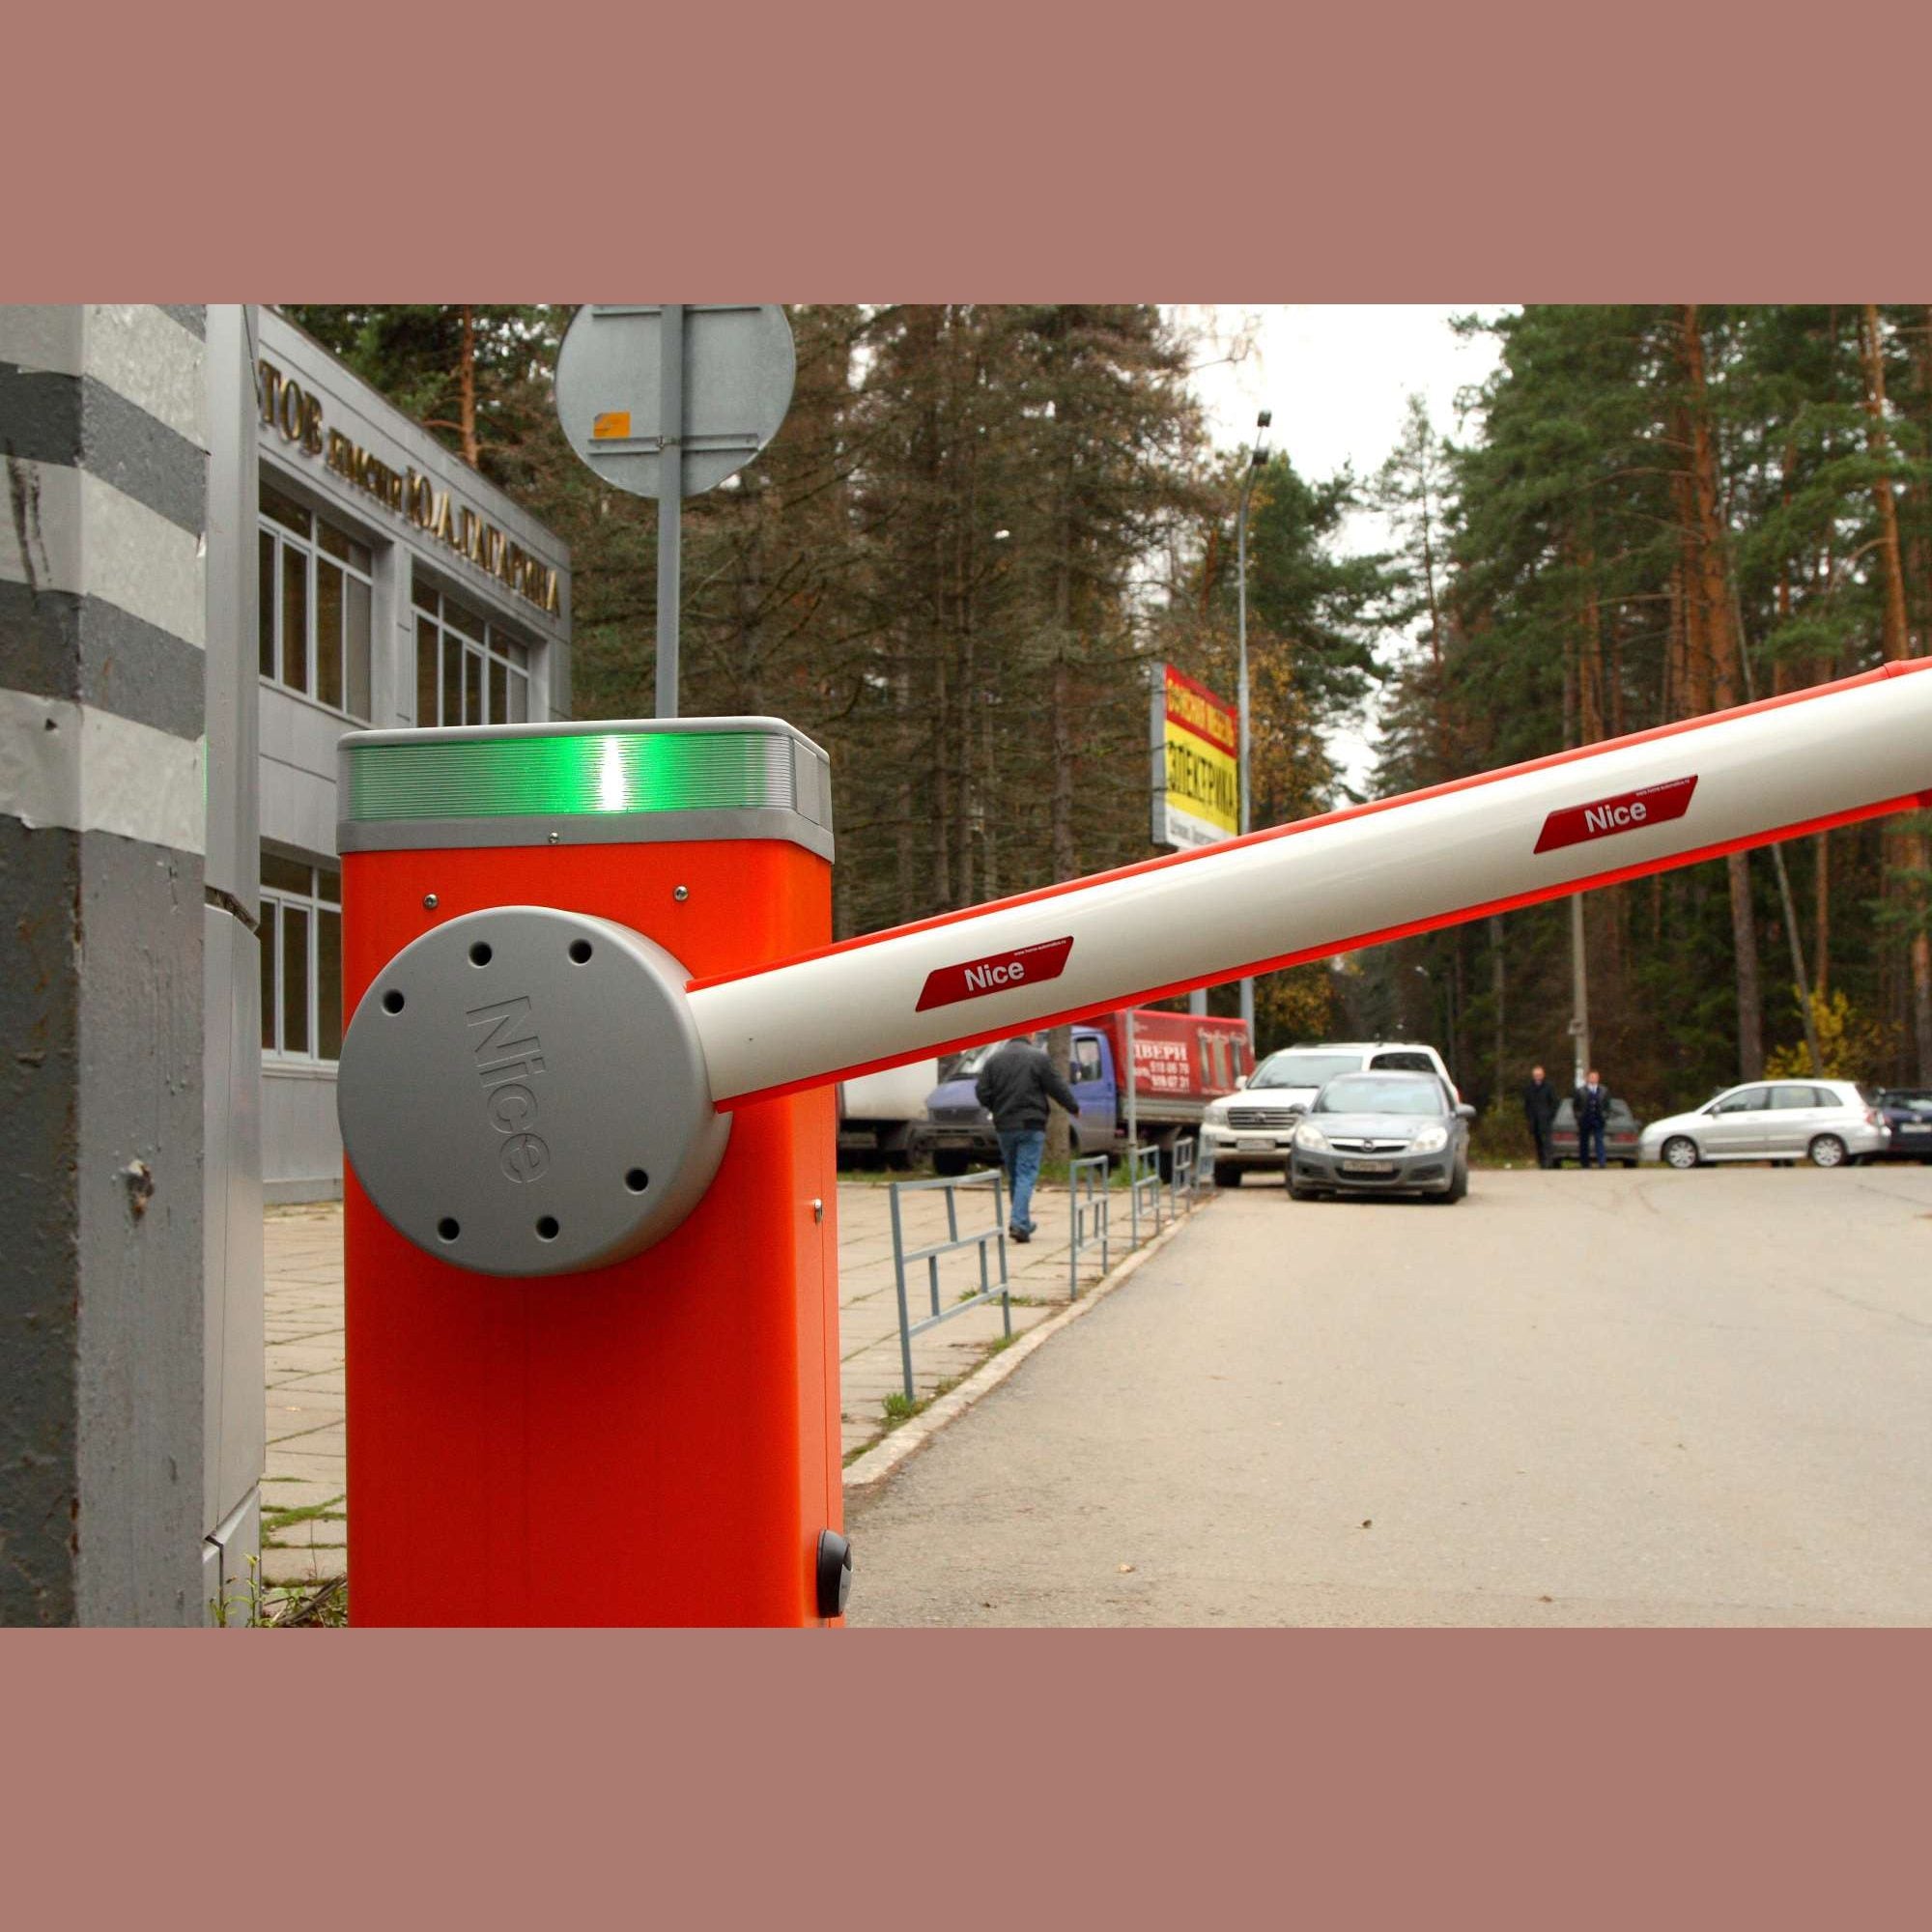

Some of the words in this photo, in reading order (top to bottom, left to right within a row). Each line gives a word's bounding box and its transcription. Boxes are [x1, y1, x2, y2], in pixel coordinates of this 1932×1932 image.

[1584, 801, 1647, 834] Nice
[964, 961, 1025, 992] Nice
[466, 995, 551, 1184] Nice
